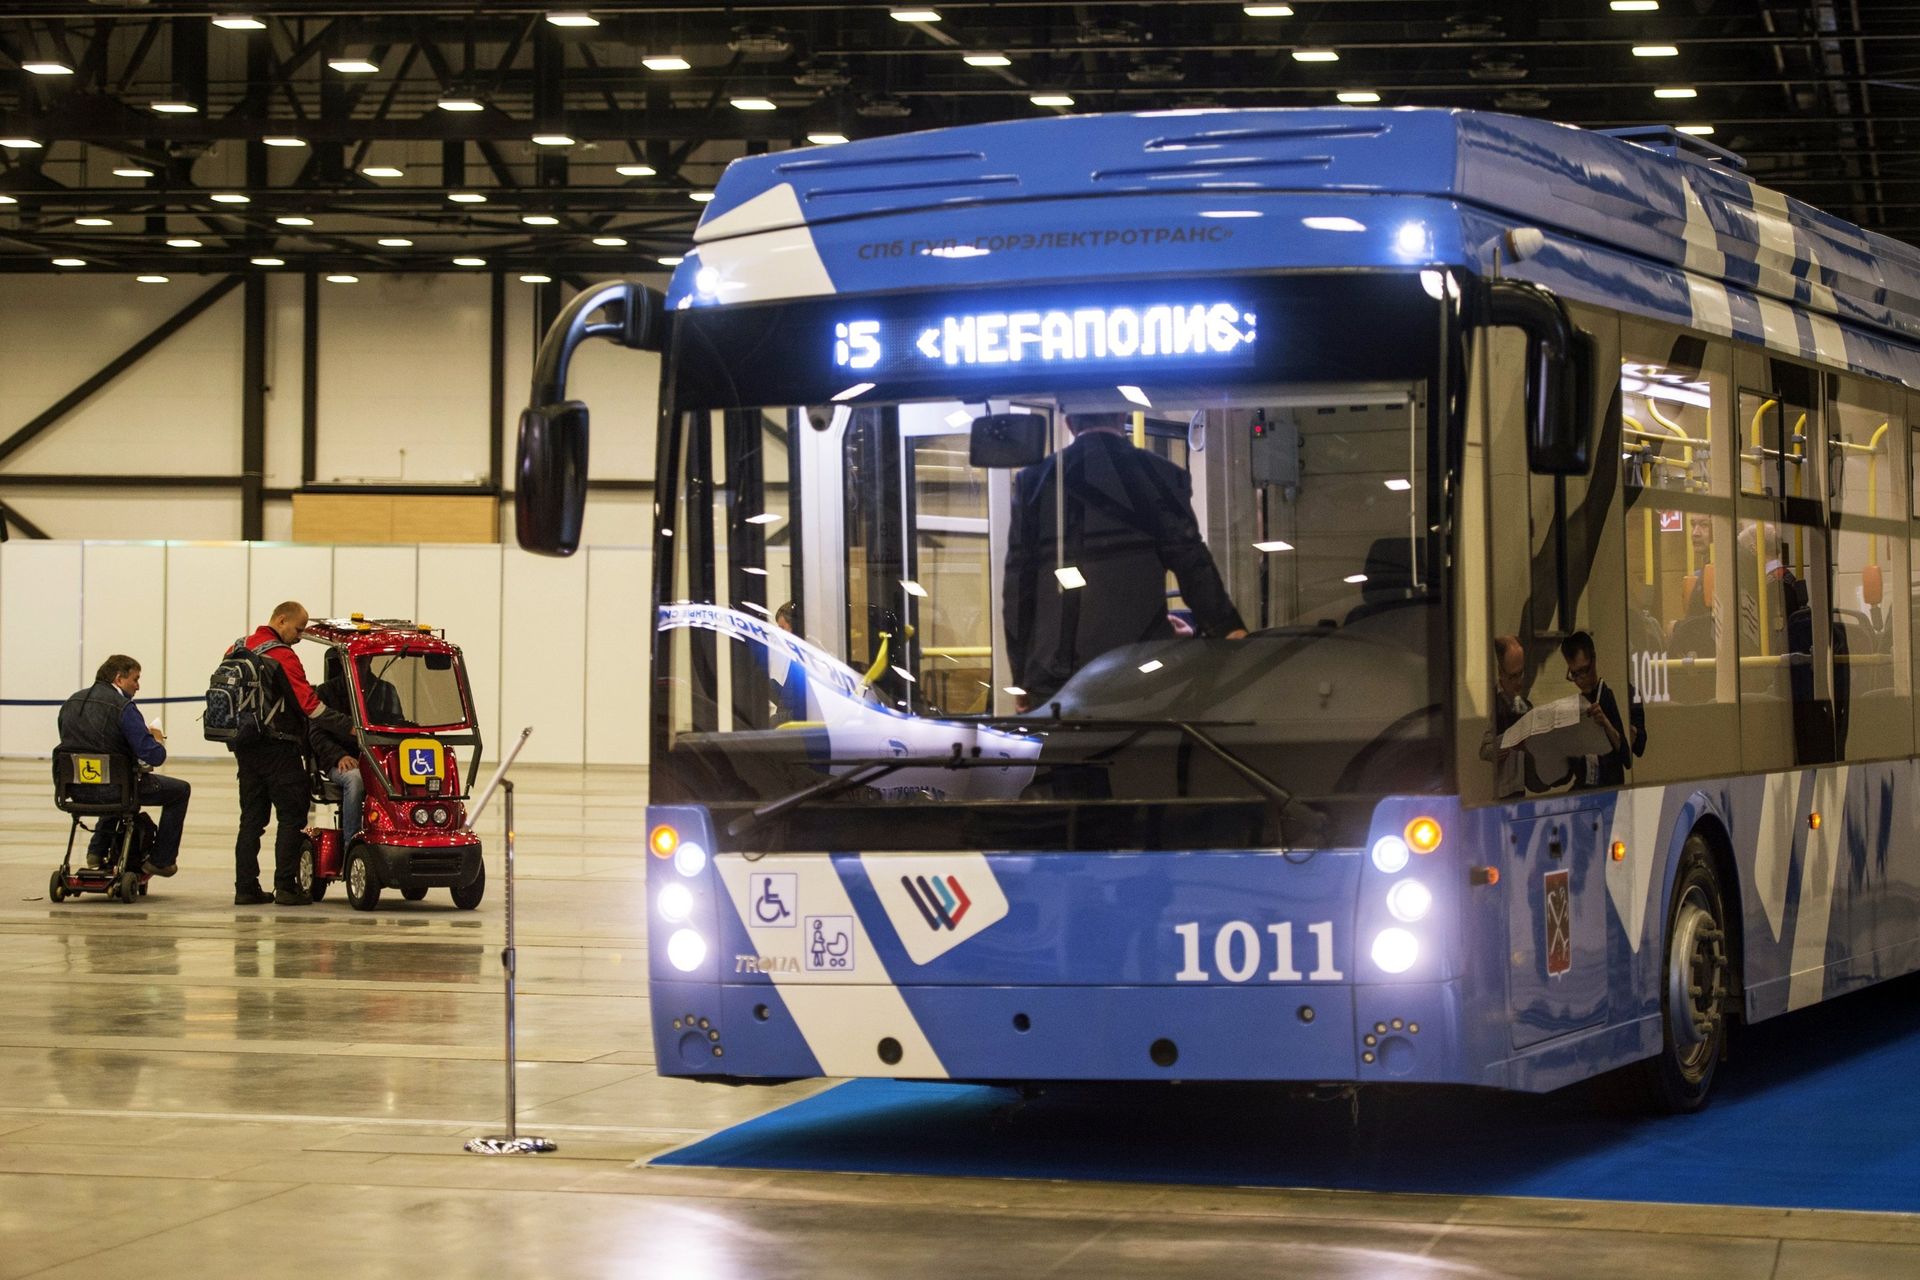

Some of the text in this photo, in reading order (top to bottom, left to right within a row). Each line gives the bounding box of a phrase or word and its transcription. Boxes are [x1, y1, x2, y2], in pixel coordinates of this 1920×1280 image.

[858, 239, 904, 260] СПб
[1631, 650, 1670, 704] 1011
[1174, 920, 1344, 982] 1011
